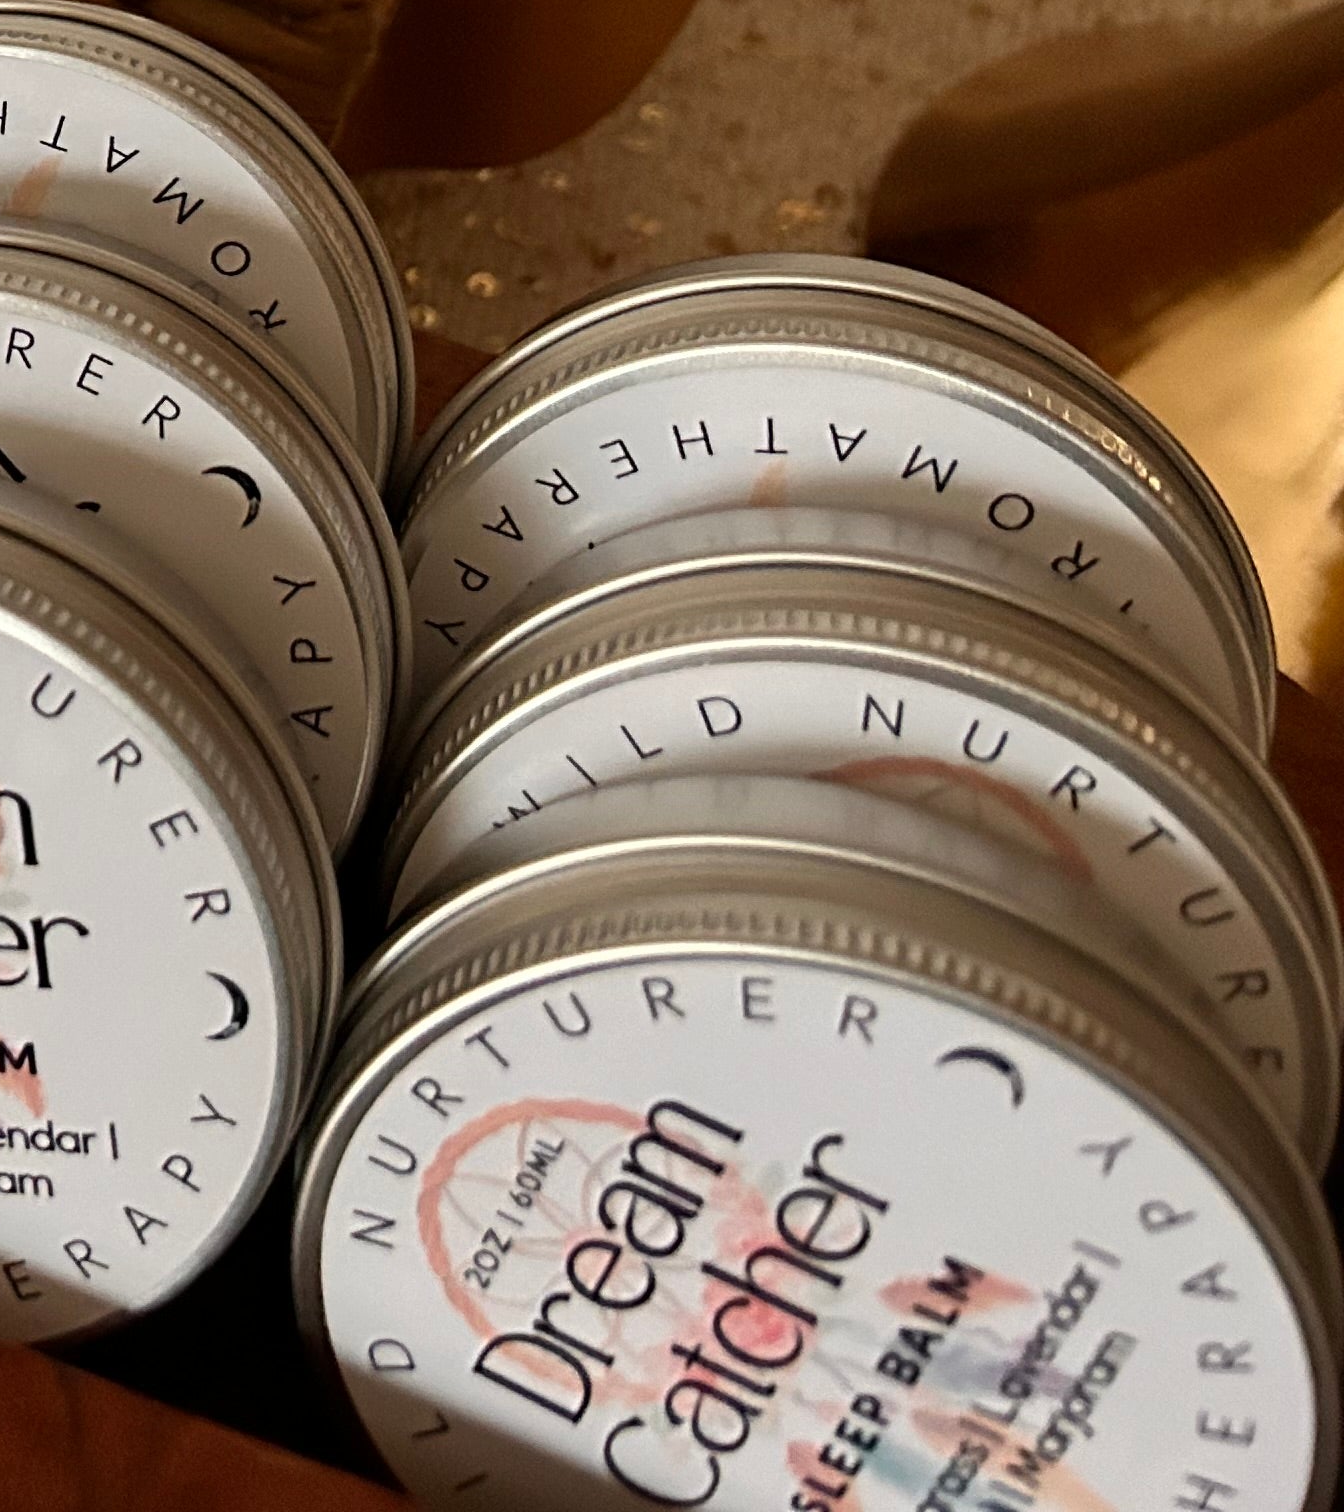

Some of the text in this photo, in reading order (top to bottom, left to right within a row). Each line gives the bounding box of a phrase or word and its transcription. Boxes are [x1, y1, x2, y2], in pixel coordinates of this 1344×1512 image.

[423, 416, 1112, 645] ROMATHERAPY
[860, 693, 1285, 1078] NURTURE
[348, 976, 879, 1493] ILD NURTURER
[472, 1096, 746, 1426] Dream
[512, 1134, 568, 1216] 60ML
[603, 1131, 892, 1511] Catcher
[1078, 1132, 1260, 1512] HERAPY
[790, 1391, 896, 1512] SLEEP
[875, 1255, 988, 1389] BALM
[972, 1261, 1102, 1425] Lavendar
